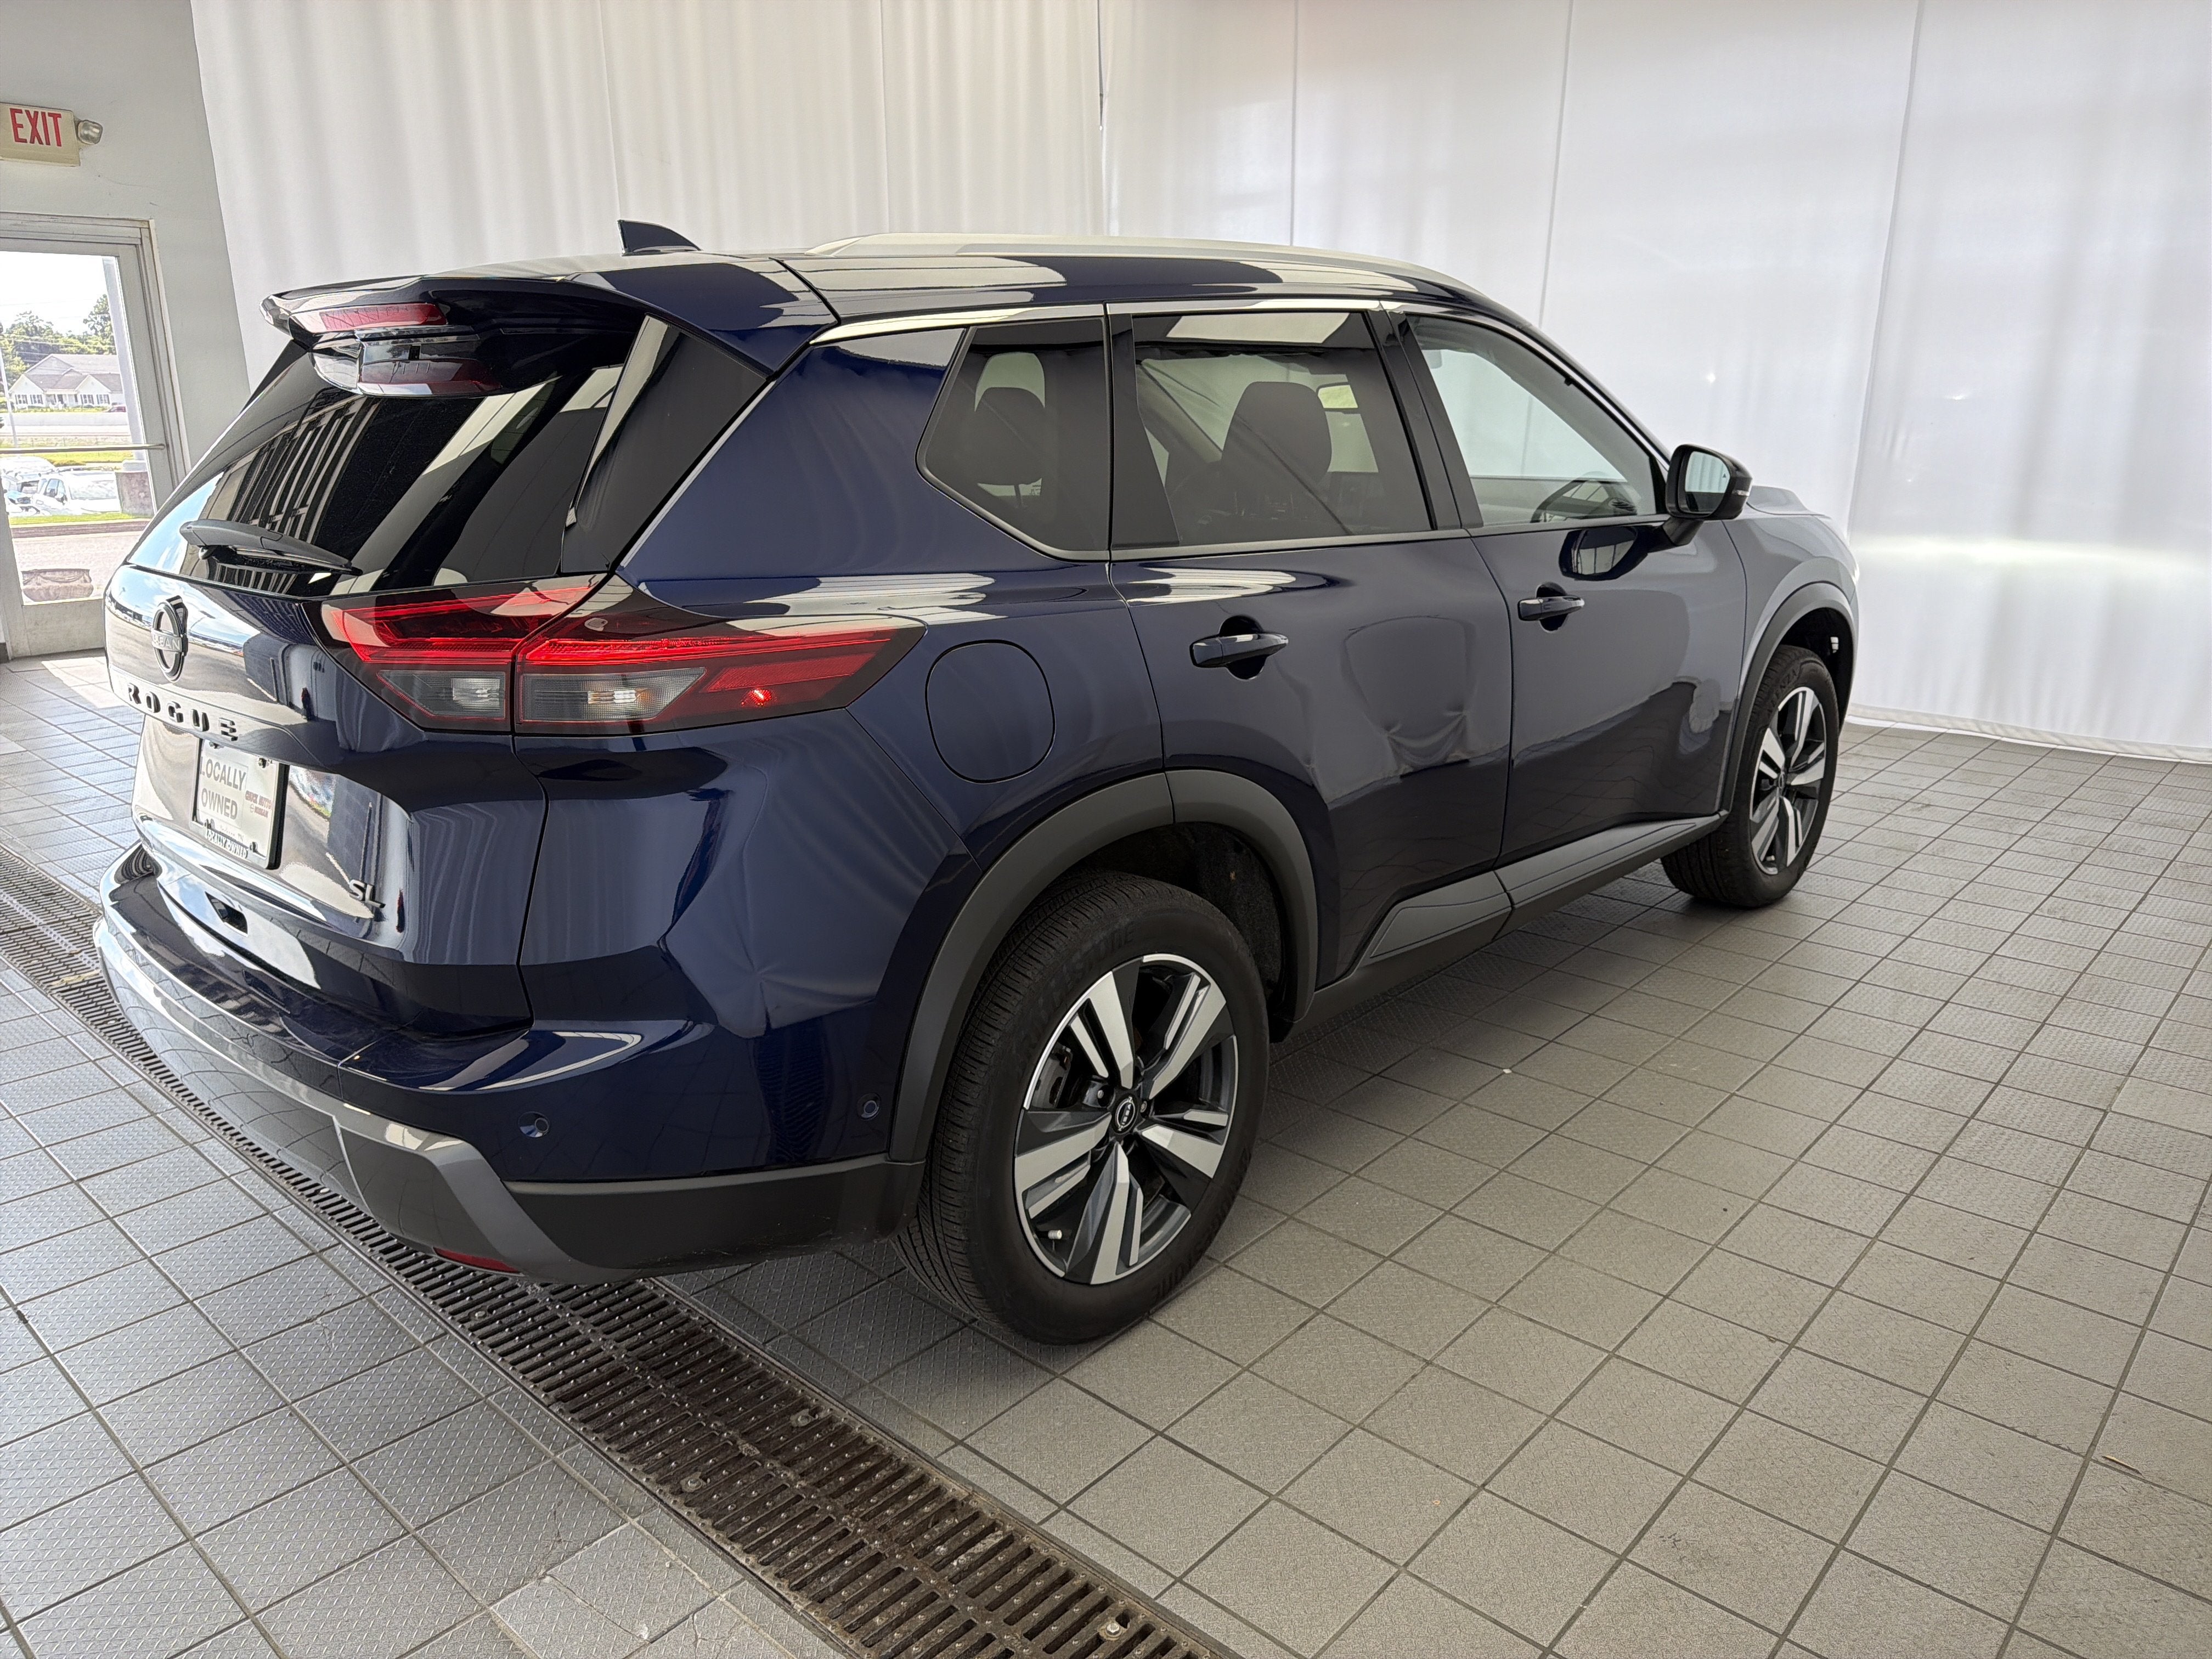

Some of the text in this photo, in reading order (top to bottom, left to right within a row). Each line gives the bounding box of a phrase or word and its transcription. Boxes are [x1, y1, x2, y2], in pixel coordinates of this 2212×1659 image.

[9, 108, 62, 147] EXIT
[127, 682, 238, 741] ROGUE
[200, 757, 246, 791] LOCALLY
[201, 788, 238, 820] OWNED
[349, 879, 386, 909] SL
